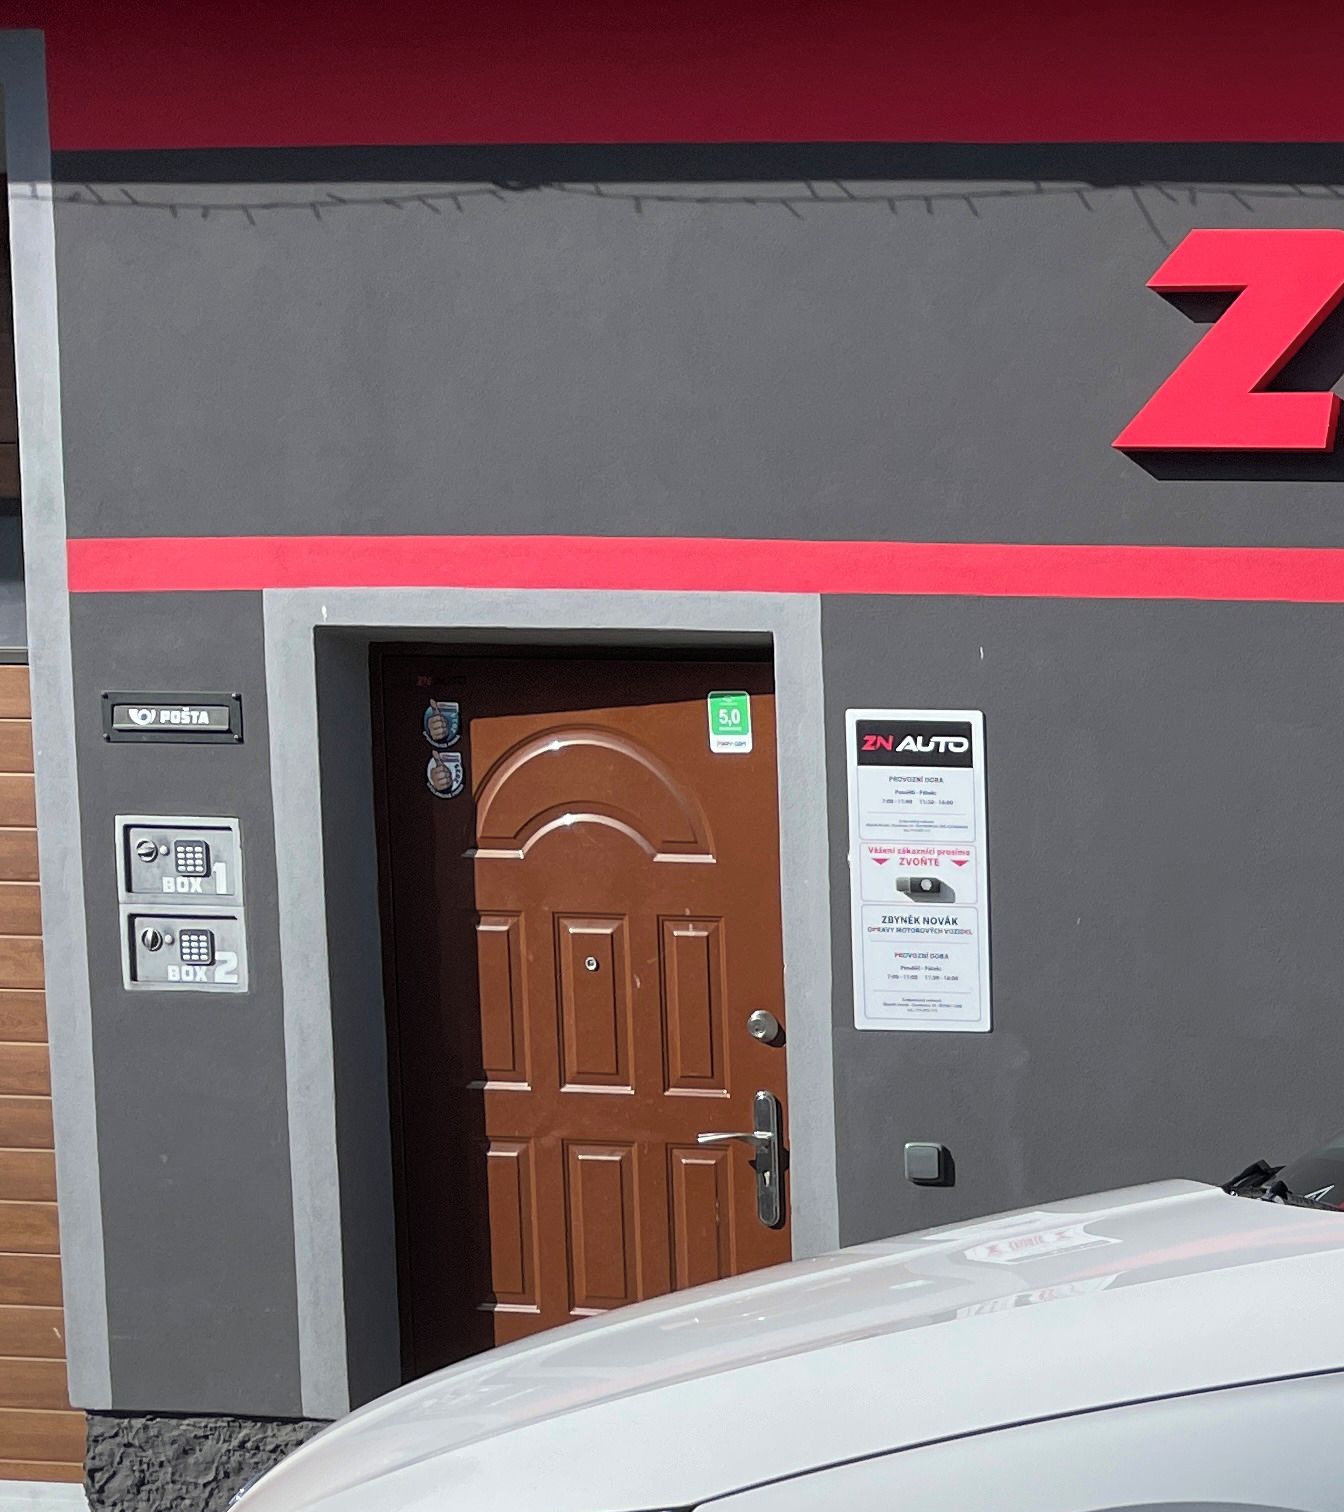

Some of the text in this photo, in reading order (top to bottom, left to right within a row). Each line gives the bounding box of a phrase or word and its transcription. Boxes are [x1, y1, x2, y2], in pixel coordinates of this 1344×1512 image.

[159, 706, 210, 725] POŠTA
[718, 708, 741, 727] 5,0
[861, 734, 970, 753] ZN AUTO
[898, 856, 940, 867] ZVOŇTE
[162, 862, 228, 894] BOX 1
[881, 914, 959, 926] ZBYNĚK NOVÁK
[895, 927, 944, 935] MOTOROVÝCH
[167, 951, 238, 983] BOX 2
